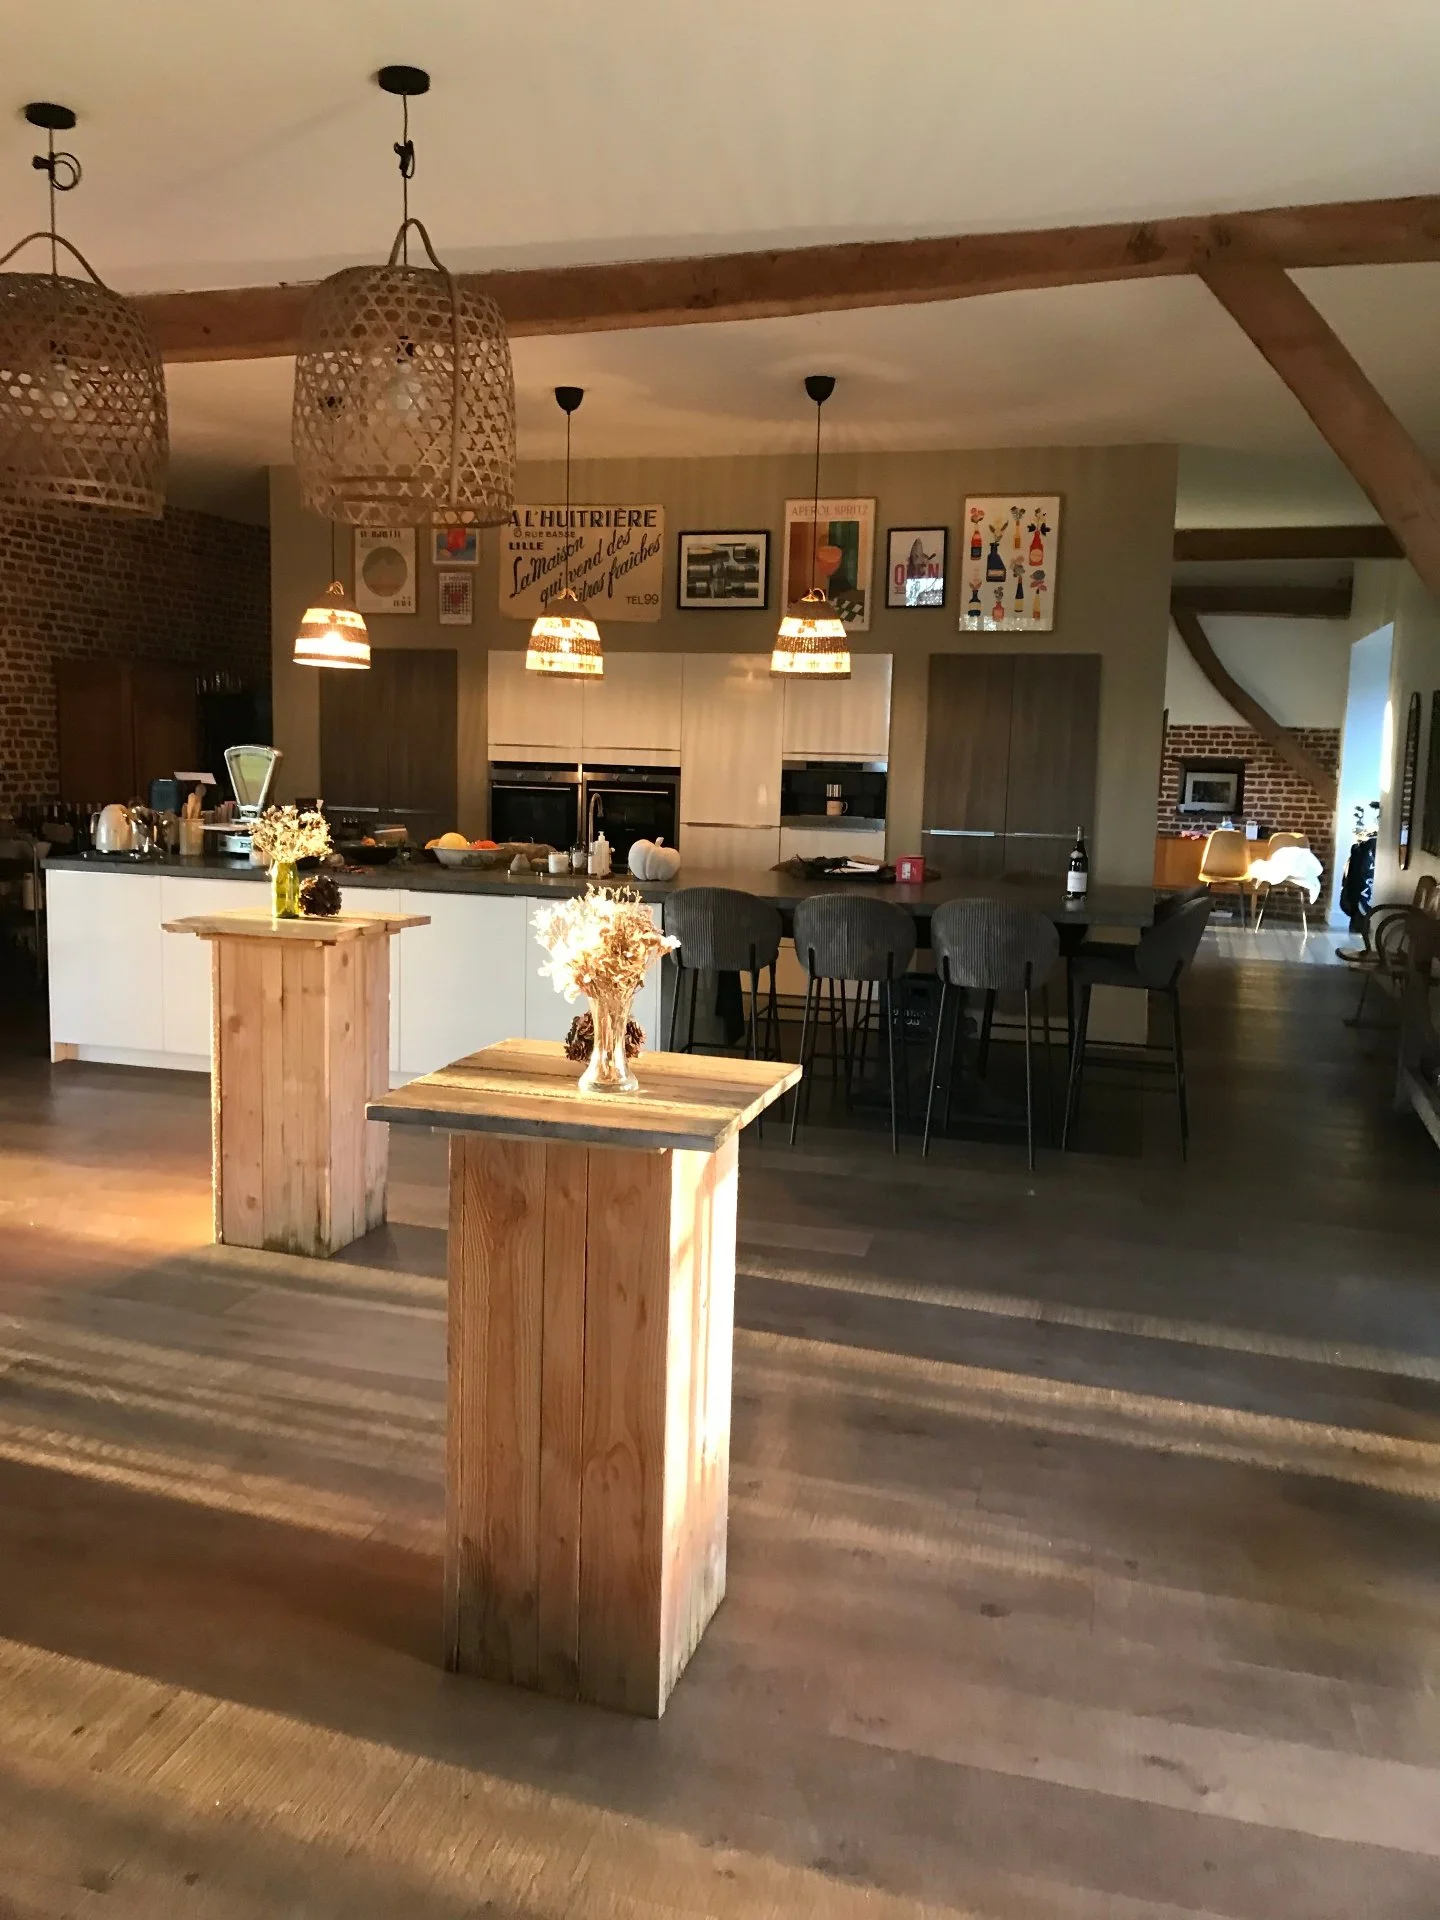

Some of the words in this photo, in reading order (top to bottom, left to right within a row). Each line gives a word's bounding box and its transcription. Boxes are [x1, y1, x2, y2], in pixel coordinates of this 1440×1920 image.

[791, 505, 829, 517] APEROL
[834, 504, 869, 517] SPRITZ
[524, 530, 544, 539] RUE
[546, 530, 576, 538] BASSE
[509, 541, 544, 551] LILLE
[540, 572, 564, 609] qui
[567, 538, 603, 583] vend
[606, 528, 632, 558] des
[509, 556, 531, 598] La
